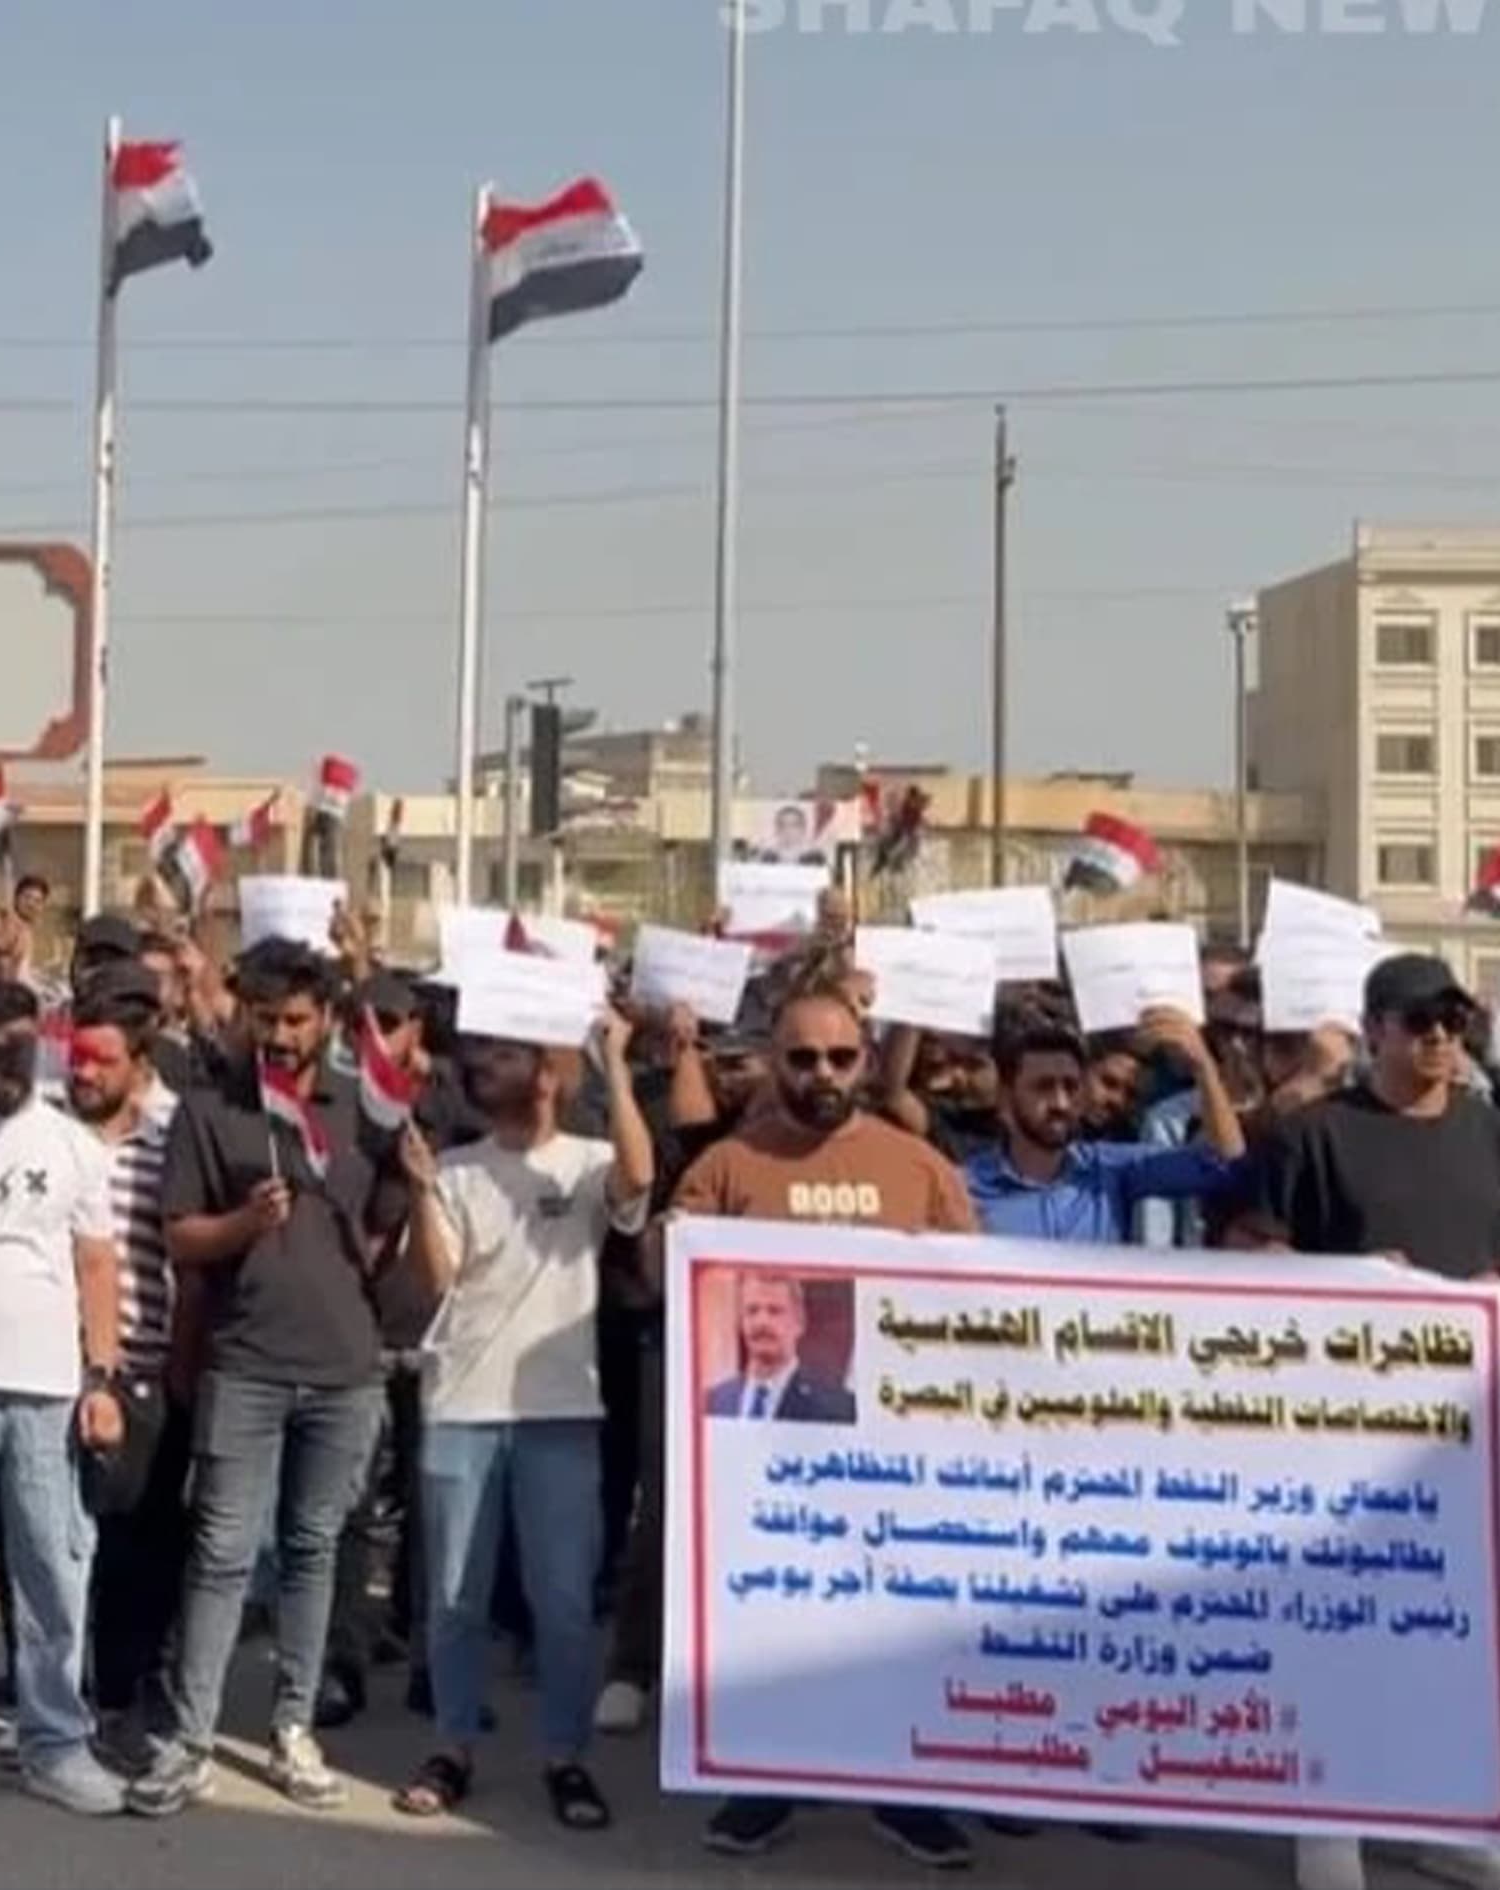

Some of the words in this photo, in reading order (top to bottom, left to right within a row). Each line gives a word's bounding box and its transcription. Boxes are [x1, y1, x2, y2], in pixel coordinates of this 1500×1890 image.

[878, 1297, 1041, 1353] الهندسية
[1188, 1317, 1308, 1374] خريجي
[1324, 1322, 1474, 1372] تظاهرات
[878, 1376, 973, 1417] البصرة
[982, 1377, 1009, 1430] في
[1181, 1390, 1286, 1433] النفطية
[766, 1451, 924, 1488] المتظاهرين
[1044, 1466, 1143, 1506] المحترم
[1156, 1468, 1238, 1505] النفط
[1248, 1477, 1314, 1516] وزير
[752, 1500, 847, 1544] موافقة
[1060, 1524, 1150, 1558] معهم
[1167, 1527, 1290, 1572] بالوقوف
[1302, 1536, 1445, 1580] يطالبونك
[728, 1564, 812, 1602] يومي
[821, 1552, 874, 1602] أجر
[885, 1563, 957, 1602] بصفة
[970, 1572, 1086, 1609] تشغيلنا
[1098, 1582, 1159, 1619] على
[1282, 1590, 1376, 1633] الوزراء
[1390, 1595, 1470, 1638] رئيس
[980, 1623, 1088, 1661] النفط
[1099, 1627, 1178, 1674] وزارة
[1188, 1639, 1273, 1676] ضمن
[944, 1677, 1056, 1723] مطلبنا
[1095, 1693, 1198, 1739] اليومي
[1205, 1686, 1271, 1736] الأجر
[1139, 1743, 1300, 1788] التشغيل
